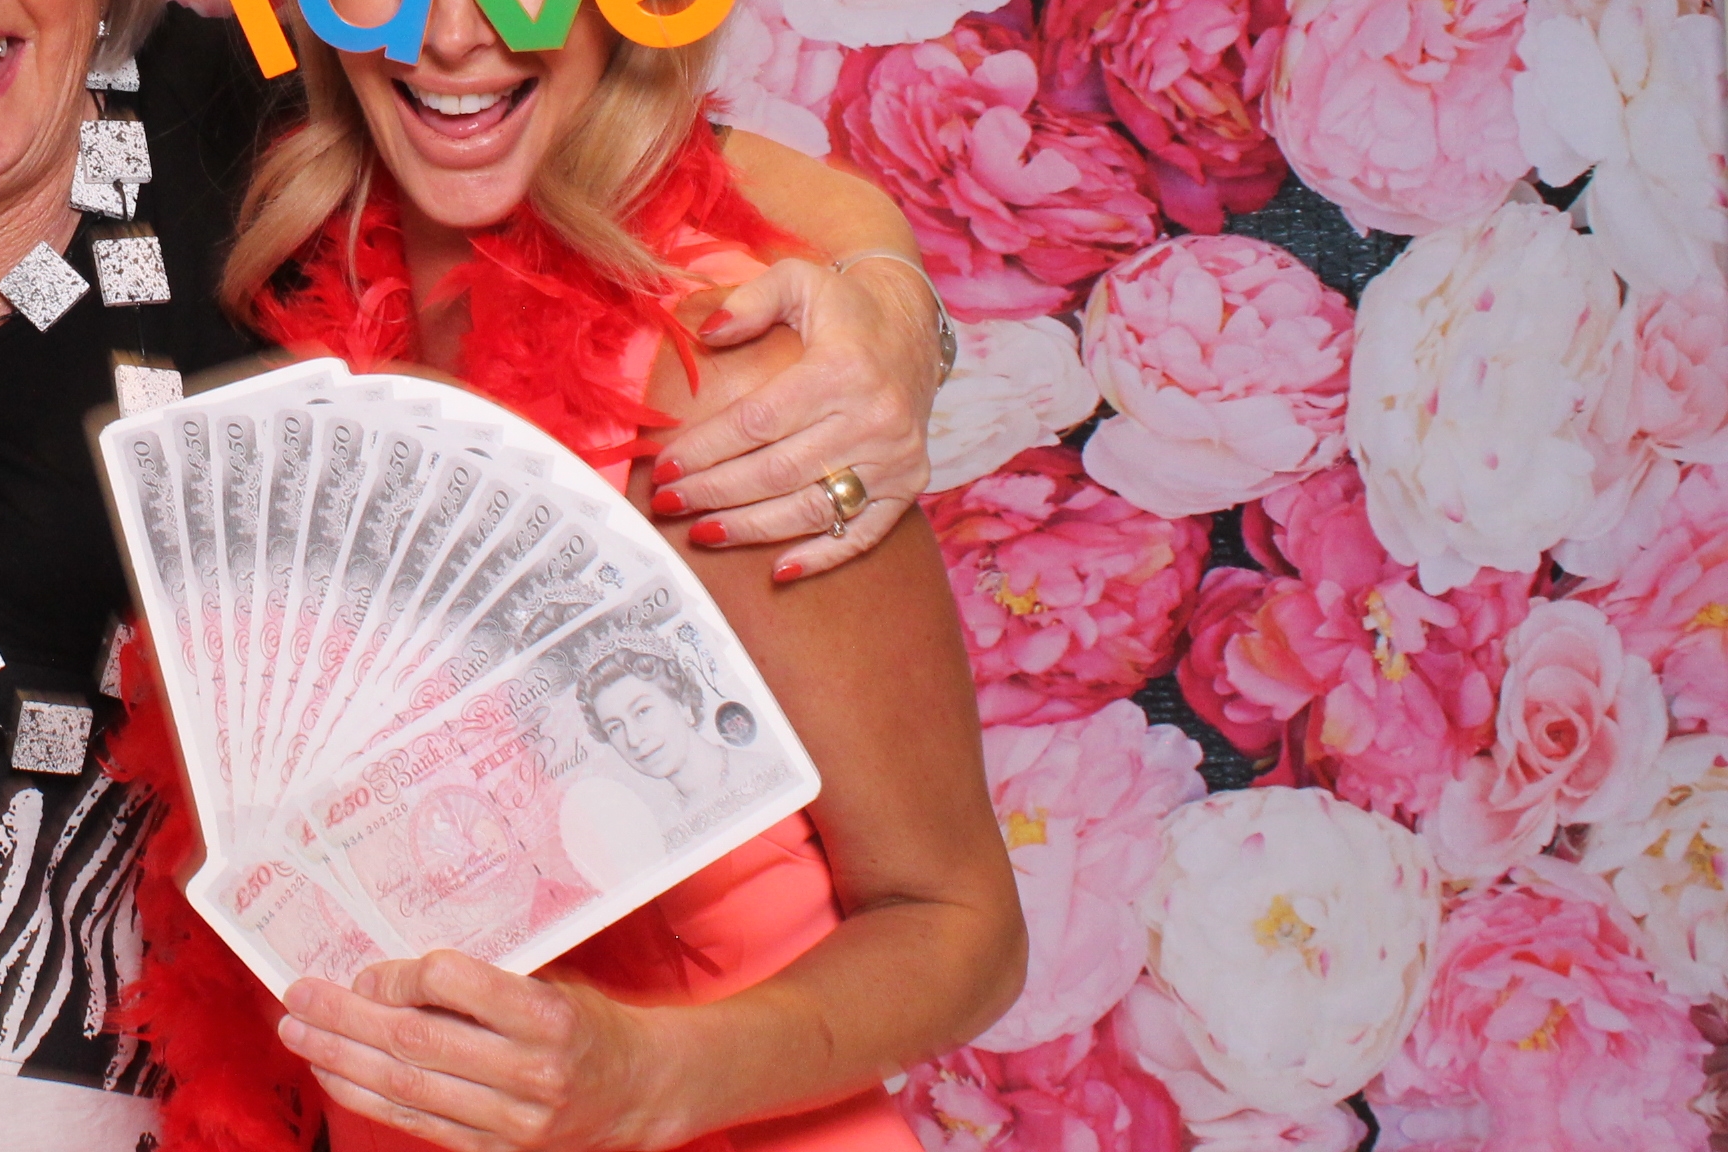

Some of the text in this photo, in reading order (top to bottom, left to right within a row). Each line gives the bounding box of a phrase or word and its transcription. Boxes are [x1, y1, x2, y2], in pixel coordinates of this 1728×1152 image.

[133, 439, 160, 492] £50
[182, 420, 206, 476] £50
[226, 422, 248, 477] £50
[283, 416, 302, 475] £50
[329, 424, 352, 482] £50
[383, 440, 411, 495] £50
[438, 466, 470, 520] £50
[475, 489, 510, 543] £50
[513, 504, 551, 558] £50
[545, 534, 585, 581] £50
[625, 587, 670, 626] £50
[363, 737, 444, 804] Bank
[461, 667, 550, 728] England
[469, 723, 545, 780] FIFTY
[496, 737, 589, 809] Pounds
[324, 786, 370, 829] £50
[341, 831, 364, 849] N34
[366, 802, 409, 835] 202220
[236, 864, 273, 914] £50
[255, 909, 276, 932] N34
